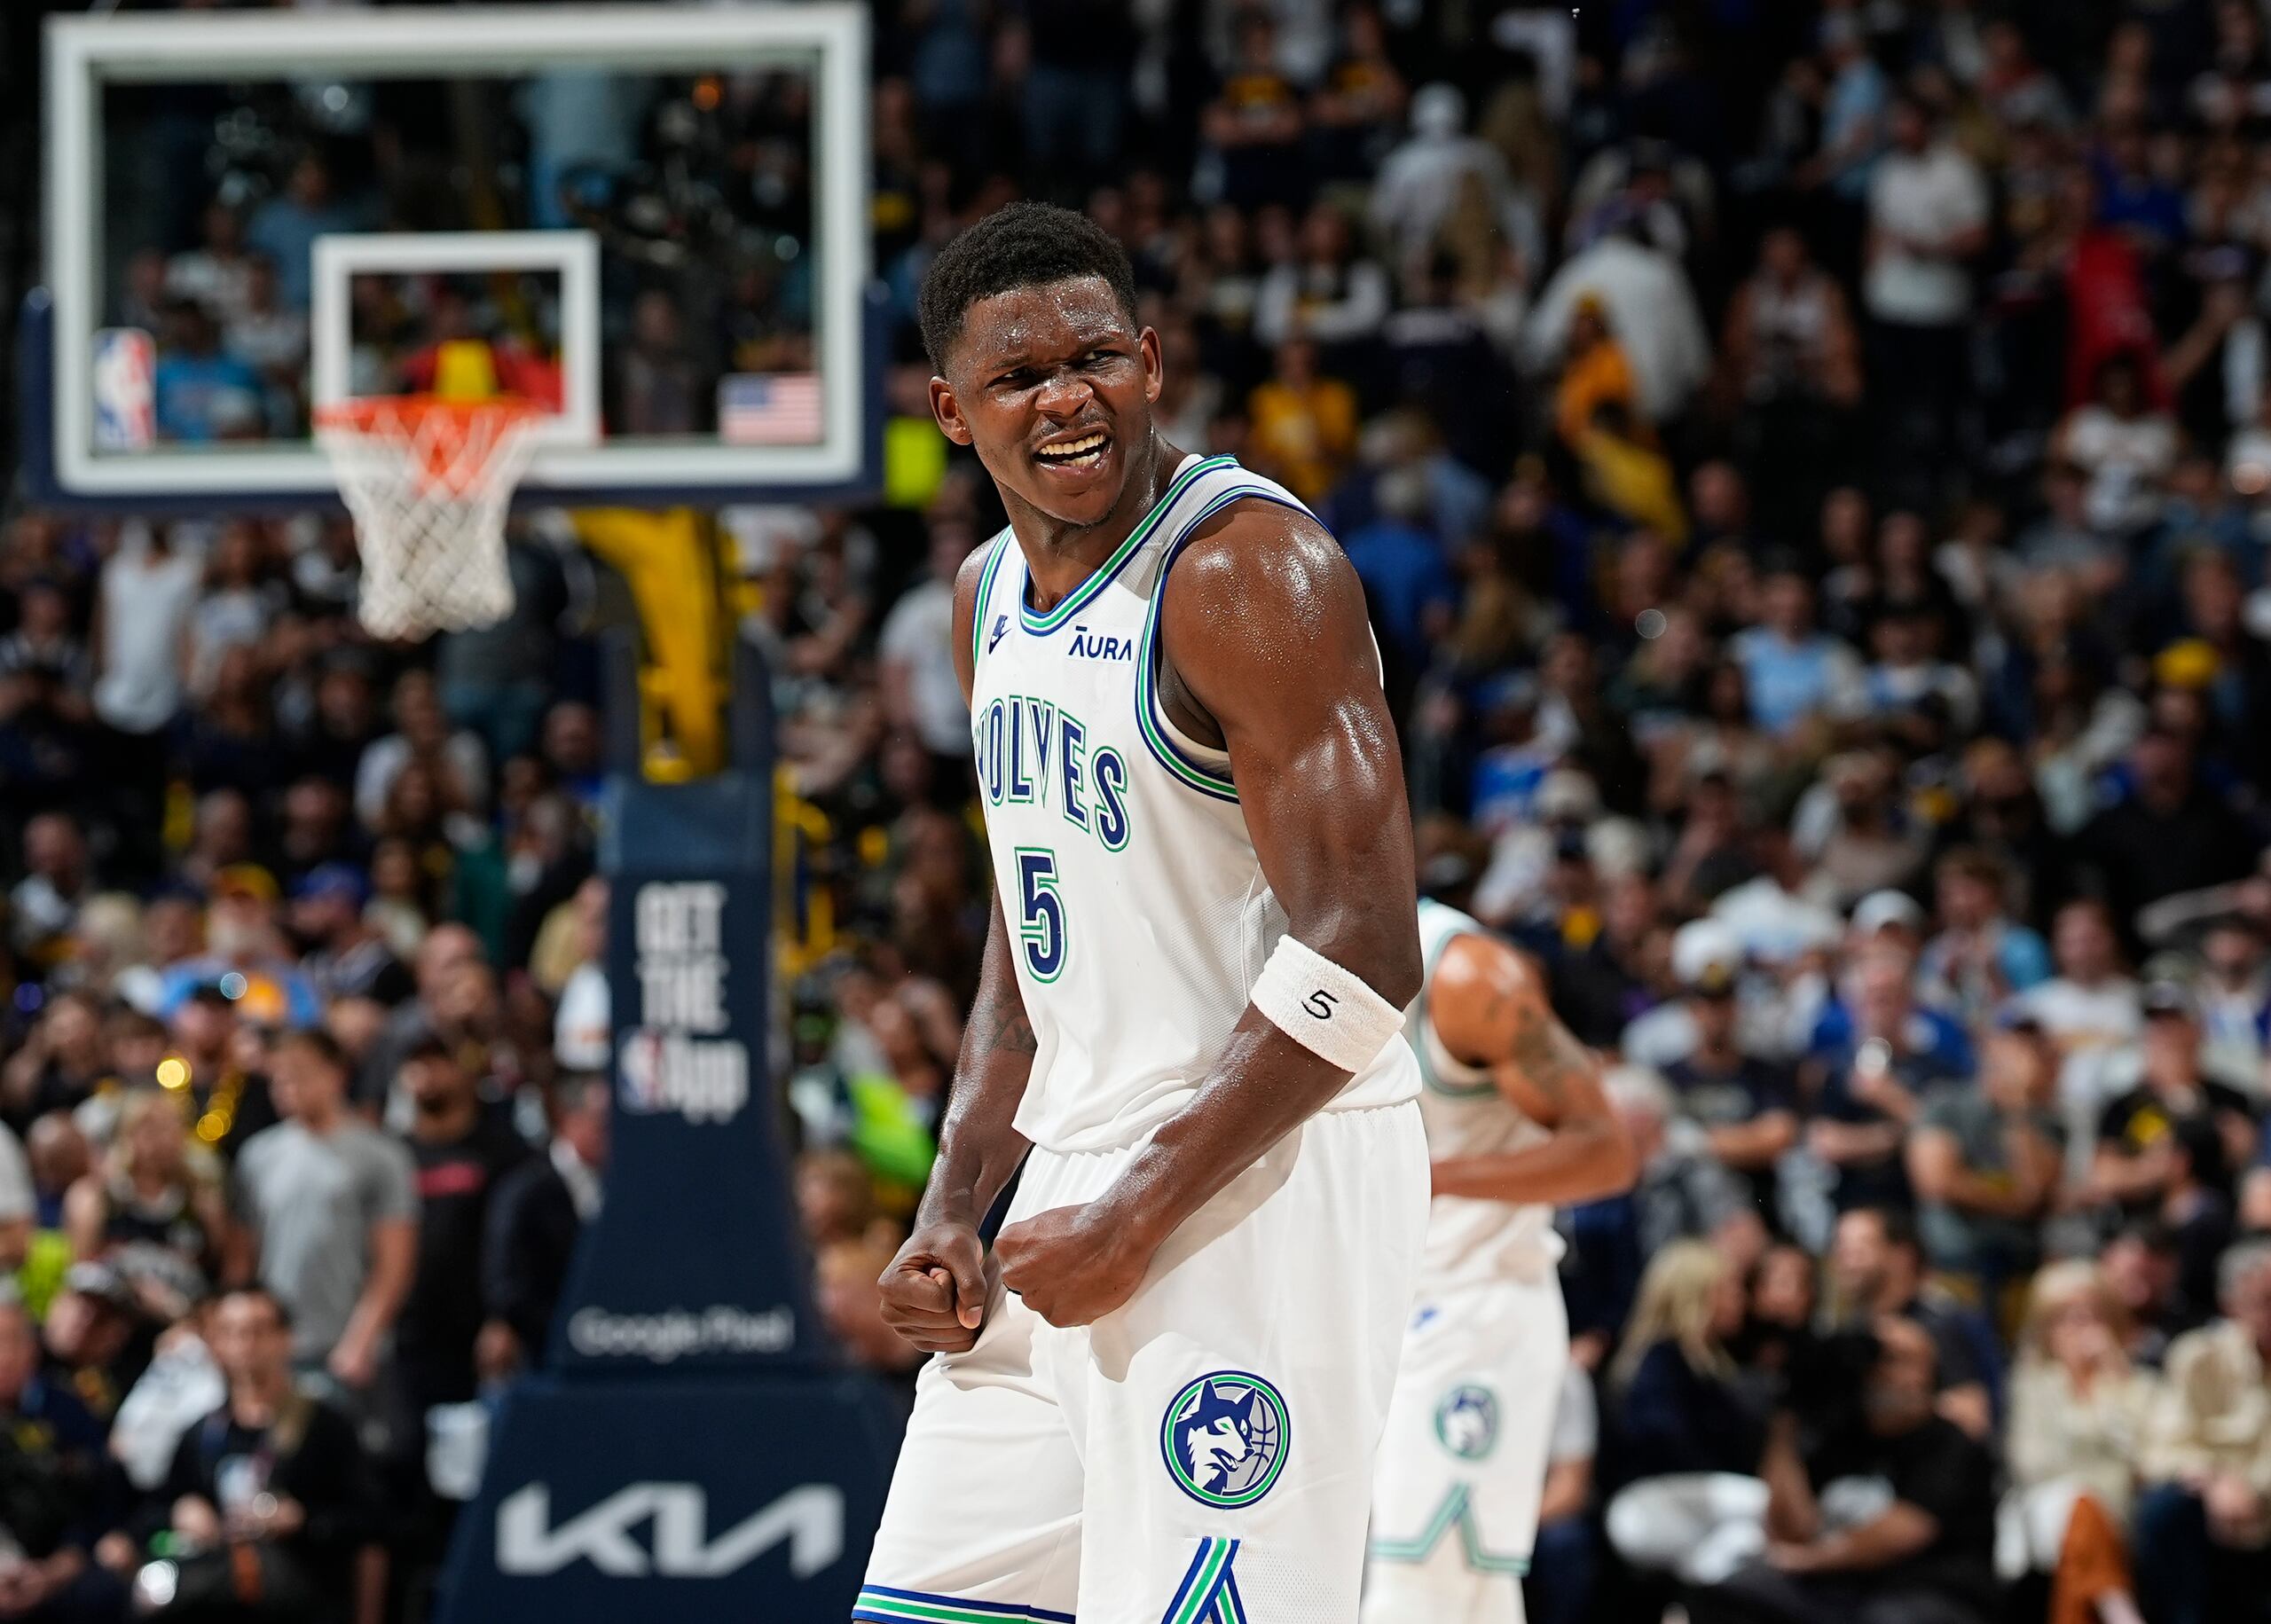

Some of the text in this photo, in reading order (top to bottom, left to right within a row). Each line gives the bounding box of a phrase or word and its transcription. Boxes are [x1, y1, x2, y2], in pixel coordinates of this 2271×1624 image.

[636, 882, 727, 951] GET
[1014, 846, 1068, 984] 5
[634, 953, 730, 1032] THE
[1301, 989, 1340, 1019] 5
[568, 1305, 795, 1364] Google Pixel
[495, 1480, 845, 1579] KIA
